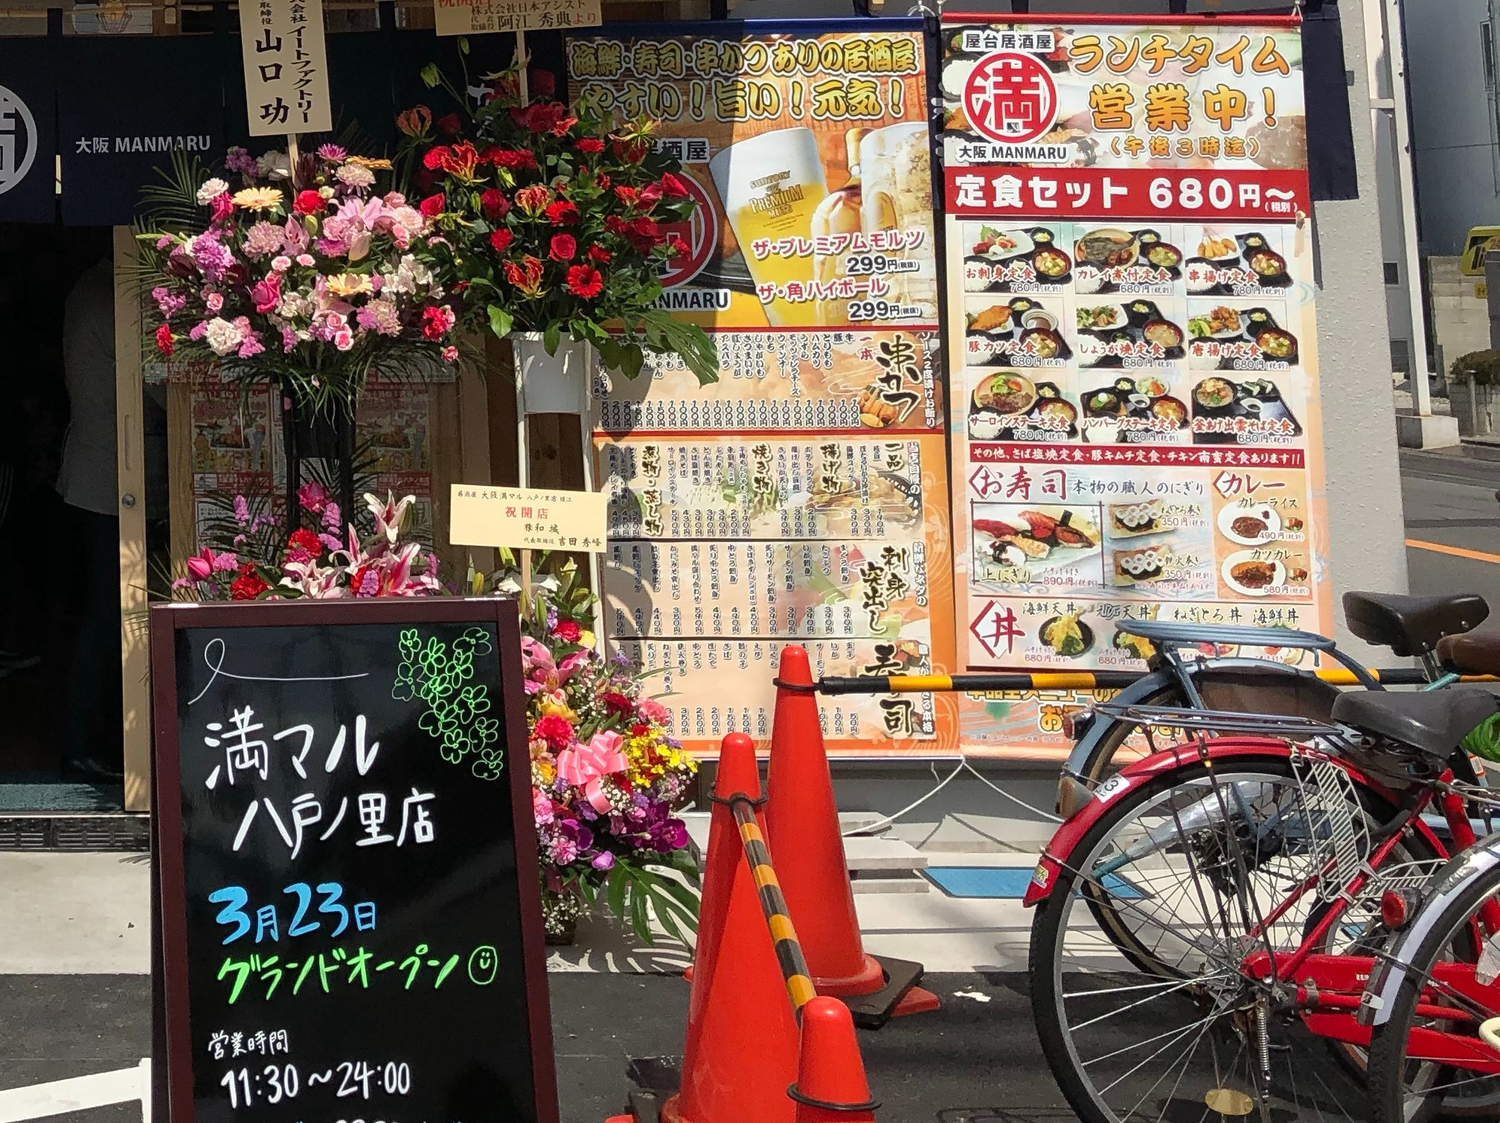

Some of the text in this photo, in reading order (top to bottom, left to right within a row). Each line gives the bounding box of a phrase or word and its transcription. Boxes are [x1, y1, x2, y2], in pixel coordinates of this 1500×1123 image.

[471, 0, 586, 15] 株式会社日本アシスト
[965, 32, 1053, 50] 屋台居酒屋
[1068, 33, 1292, 76] ランチタイム
[964, 52, 1058, 144] 満
[1088, 83, 1279, 132] 営業中!
[75, 134, 211, 154] 大阪 MANMARU
[958, 145, 1068, 161] 大阪 MANMARU
[748, 184, 804, 214] PREMIUM
[955, 173, 1129, 210] 定食セット
[752, 230, 925, 259] ザ・プレミアムモルツ
[757, 277, 887, 303] ザ・角ハイボール
[874, 333, 923, 423] 串かつ
[751, 443, 772, 494] 焼き物
[819, 443, 843, 493] 揚げ物
[979, 465, 1068, 501] お寿司
[1221, 471, 1287, 496] カレー
[1073, 478, 1204, 497] 本物の職人のにぎり
[505, 505, 549, 520] 祝開店
[1238, 497, 1299, 510] カレーライス
[1250, 549, 1303, 561] カツカレー
[880, 545, 909, 600] 刺身
[980, 568, 1033, 584] 上にぎり
[859, 562, 887, 633] 突出し
[1022, 601, 1078, 617] 海鮮天丼
[981, 607, 1026, 654] 丼
[1173, 607, 1244, 625] ねぎとろ丼
[1253, 608, 1300, 624] 海鮮丼
[203, 705, 381, 790] 満マル
[231, 786, 437, 861] 八戸ノ里店
[207, 881, 378, 945] 3月23日
[216, 943, 461, 1006] グランドオープン
[207, 1029, 290, 1061] 営業時間
